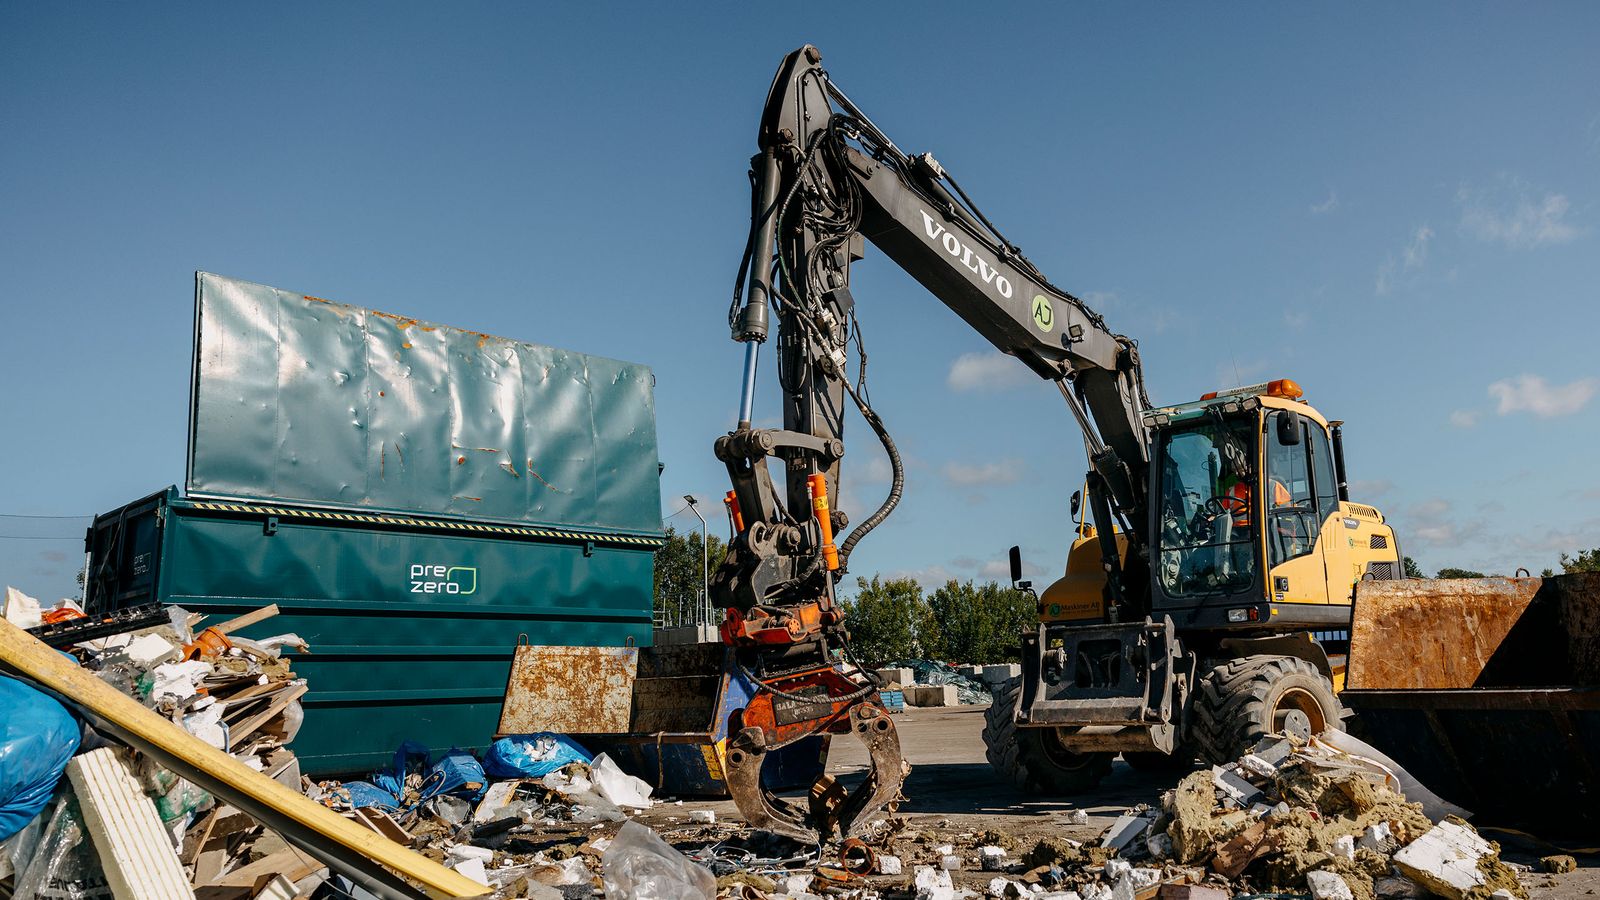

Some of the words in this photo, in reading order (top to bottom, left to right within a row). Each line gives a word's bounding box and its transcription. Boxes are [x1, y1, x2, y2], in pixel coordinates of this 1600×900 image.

[920, 209, 1012, 299] VOLVO
[1034, 301, 1052, 326] AJ
[411, 564, 446, 579] pre
[410, 581, 459, 594] zero
